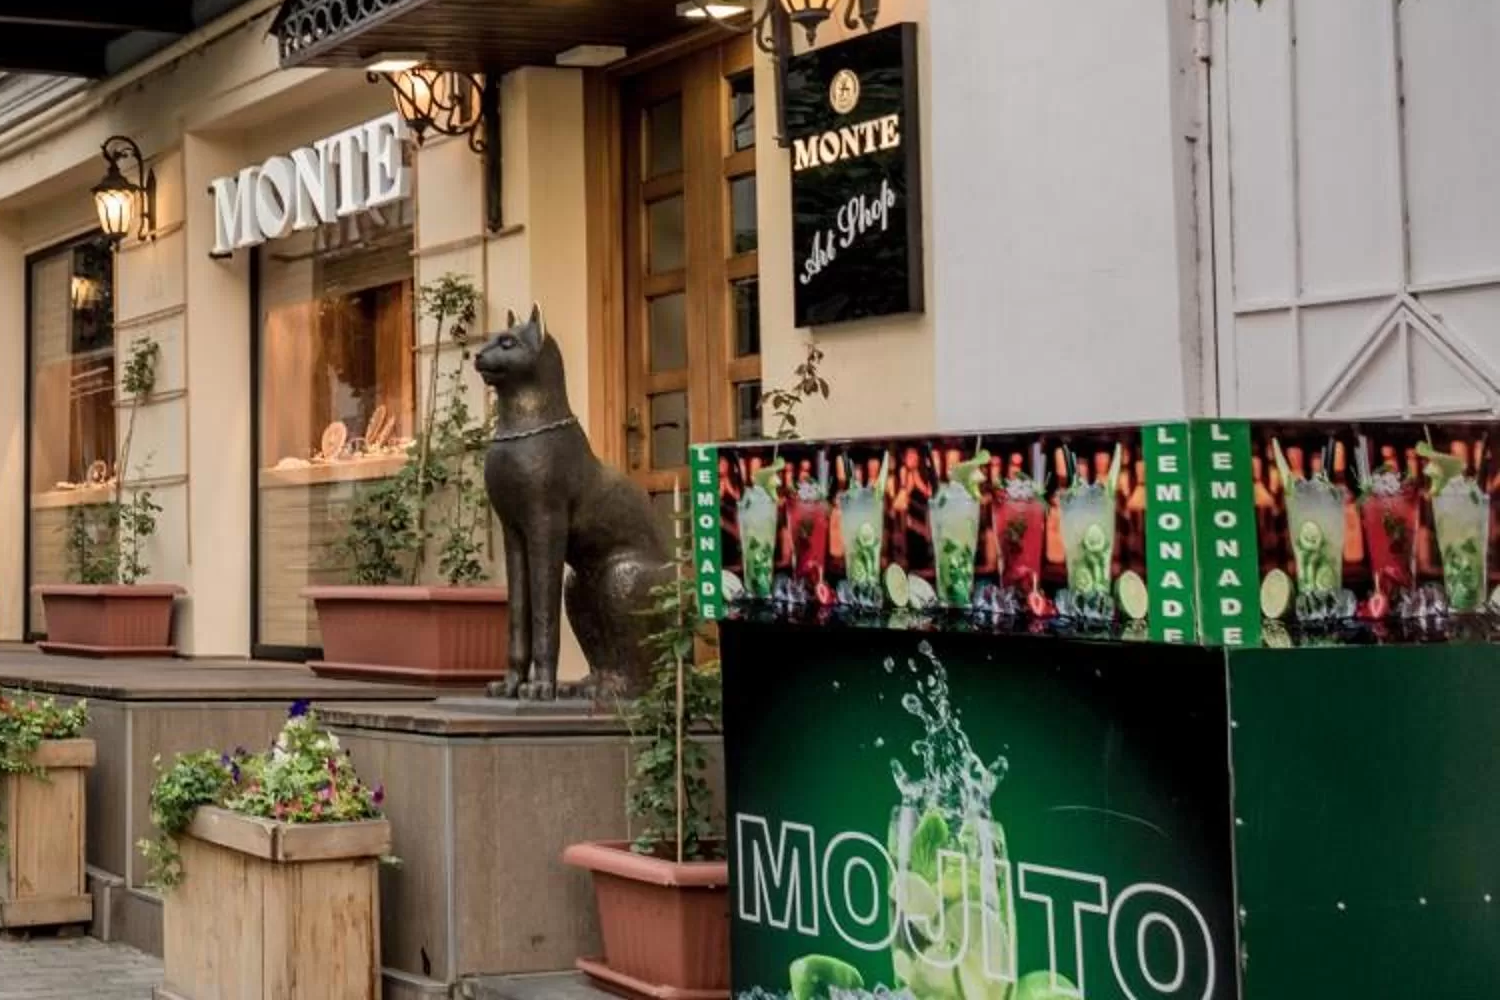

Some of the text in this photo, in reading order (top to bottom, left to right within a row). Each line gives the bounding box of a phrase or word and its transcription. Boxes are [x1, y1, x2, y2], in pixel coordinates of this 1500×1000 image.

[209, 111, 407, 254] MONTE
[793, 113, 900, 171] MONTE
[800, 178, 895, 284] Art Shop
[697, 447, 716, 619] LEMONADE
[1156, 427, 1184, 644] LEMONADE
[1211, 423, 1244, 646] LEMONADE
[736, 812, 1216, 1000] MOJITO
